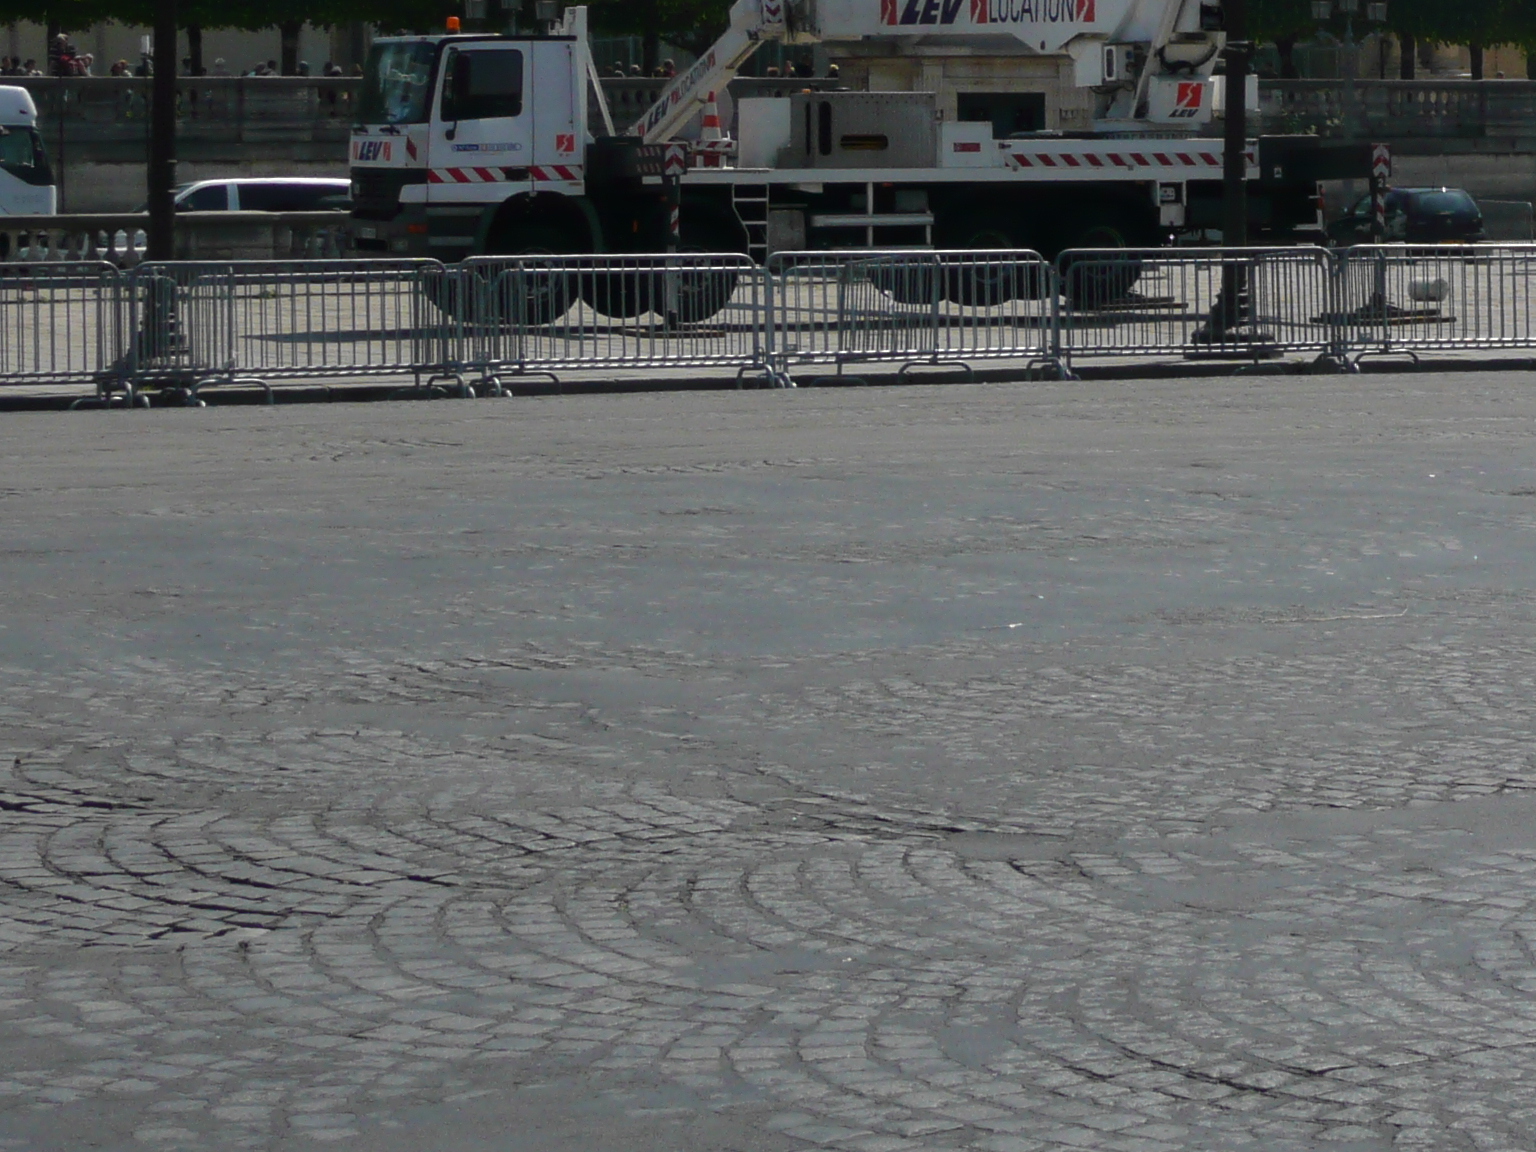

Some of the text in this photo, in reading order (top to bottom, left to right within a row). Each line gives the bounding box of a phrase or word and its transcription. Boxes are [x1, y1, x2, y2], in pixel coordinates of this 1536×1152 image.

[647, 58, 710, 133] LEV LOCATION
[1168, 109, 1199, 118] LEV
[359, 141, 383, 161] LEV
